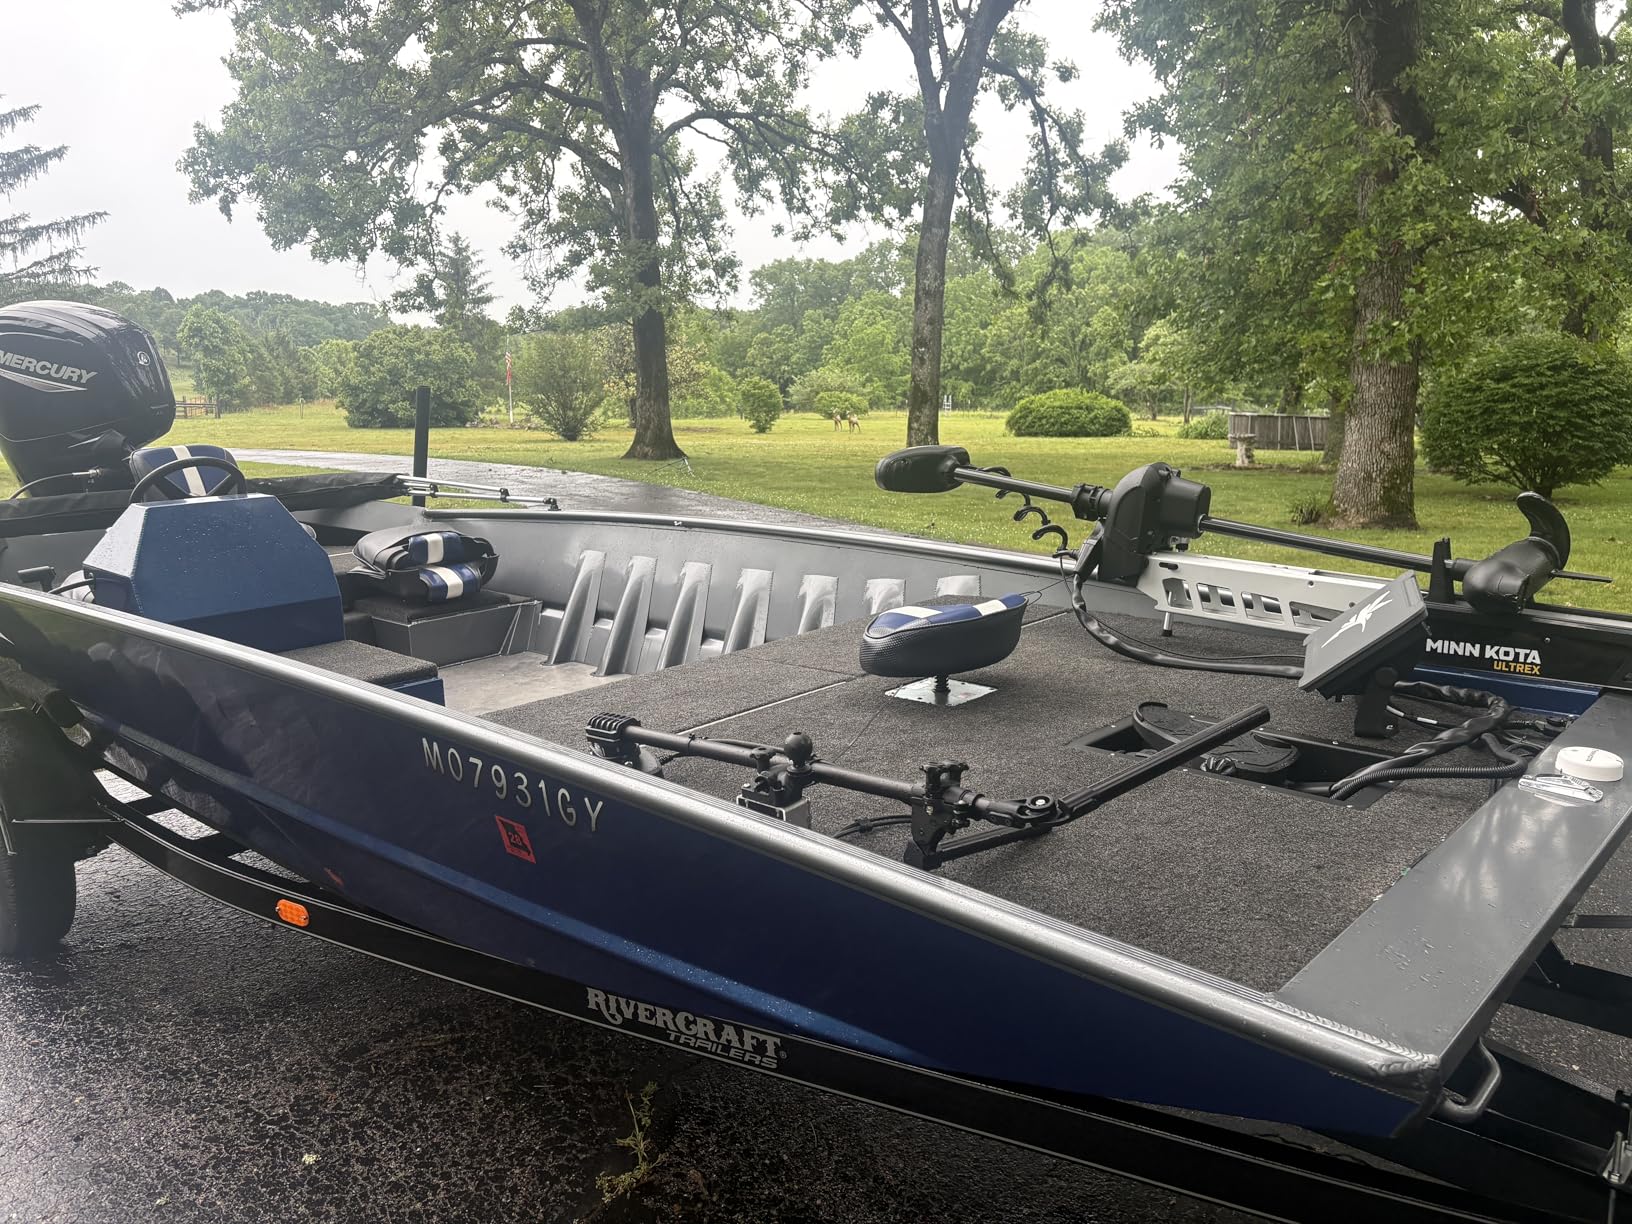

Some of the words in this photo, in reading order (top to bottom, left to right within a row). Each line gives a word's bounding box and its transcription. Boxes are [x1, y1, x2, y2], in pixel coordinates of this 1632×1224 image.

[0, 350, 98, 384] MERCURY
[1425, 638, 1481, 658] MINN
[1484, 644, 1542, 665] KOTA
[1493, 660, 1541, 675] ULTREX
[586, 987, 781, 1058] RIVERCRAFT
[666, 1030, 778, 1069] TRAILERS
